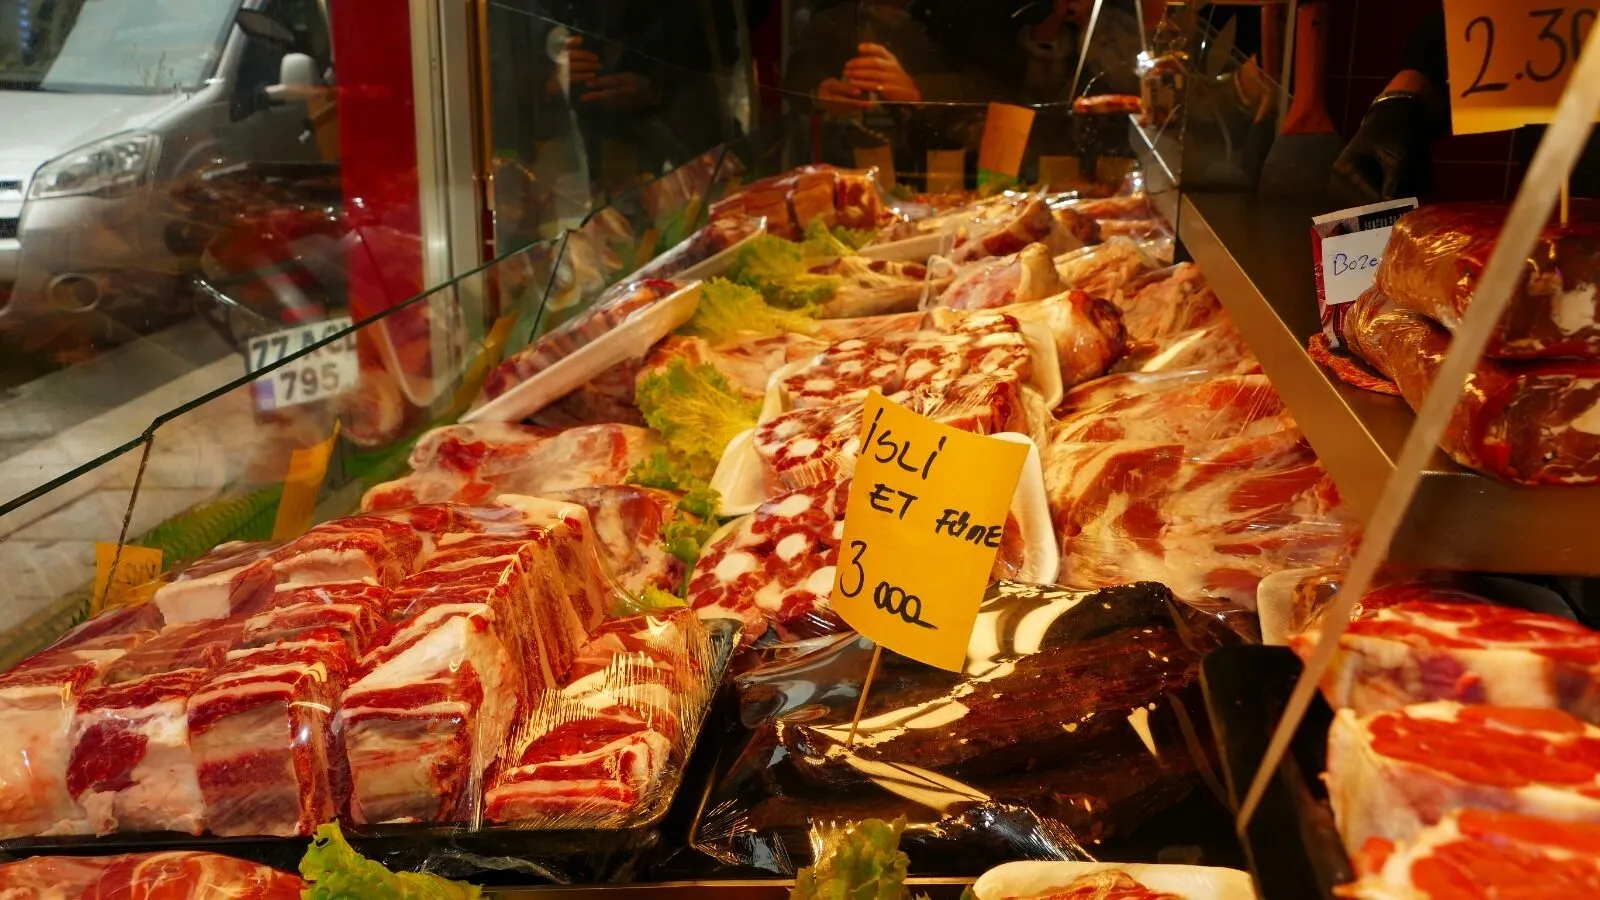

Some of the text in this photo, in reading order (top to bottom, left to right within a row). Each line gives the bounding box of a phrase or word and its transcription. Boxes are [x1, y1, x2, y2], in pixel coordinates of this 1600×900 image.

[252, 335, 289, 371] 77
[280, 362, 340, 401] 795
[869, 483, 918, 520] ET
